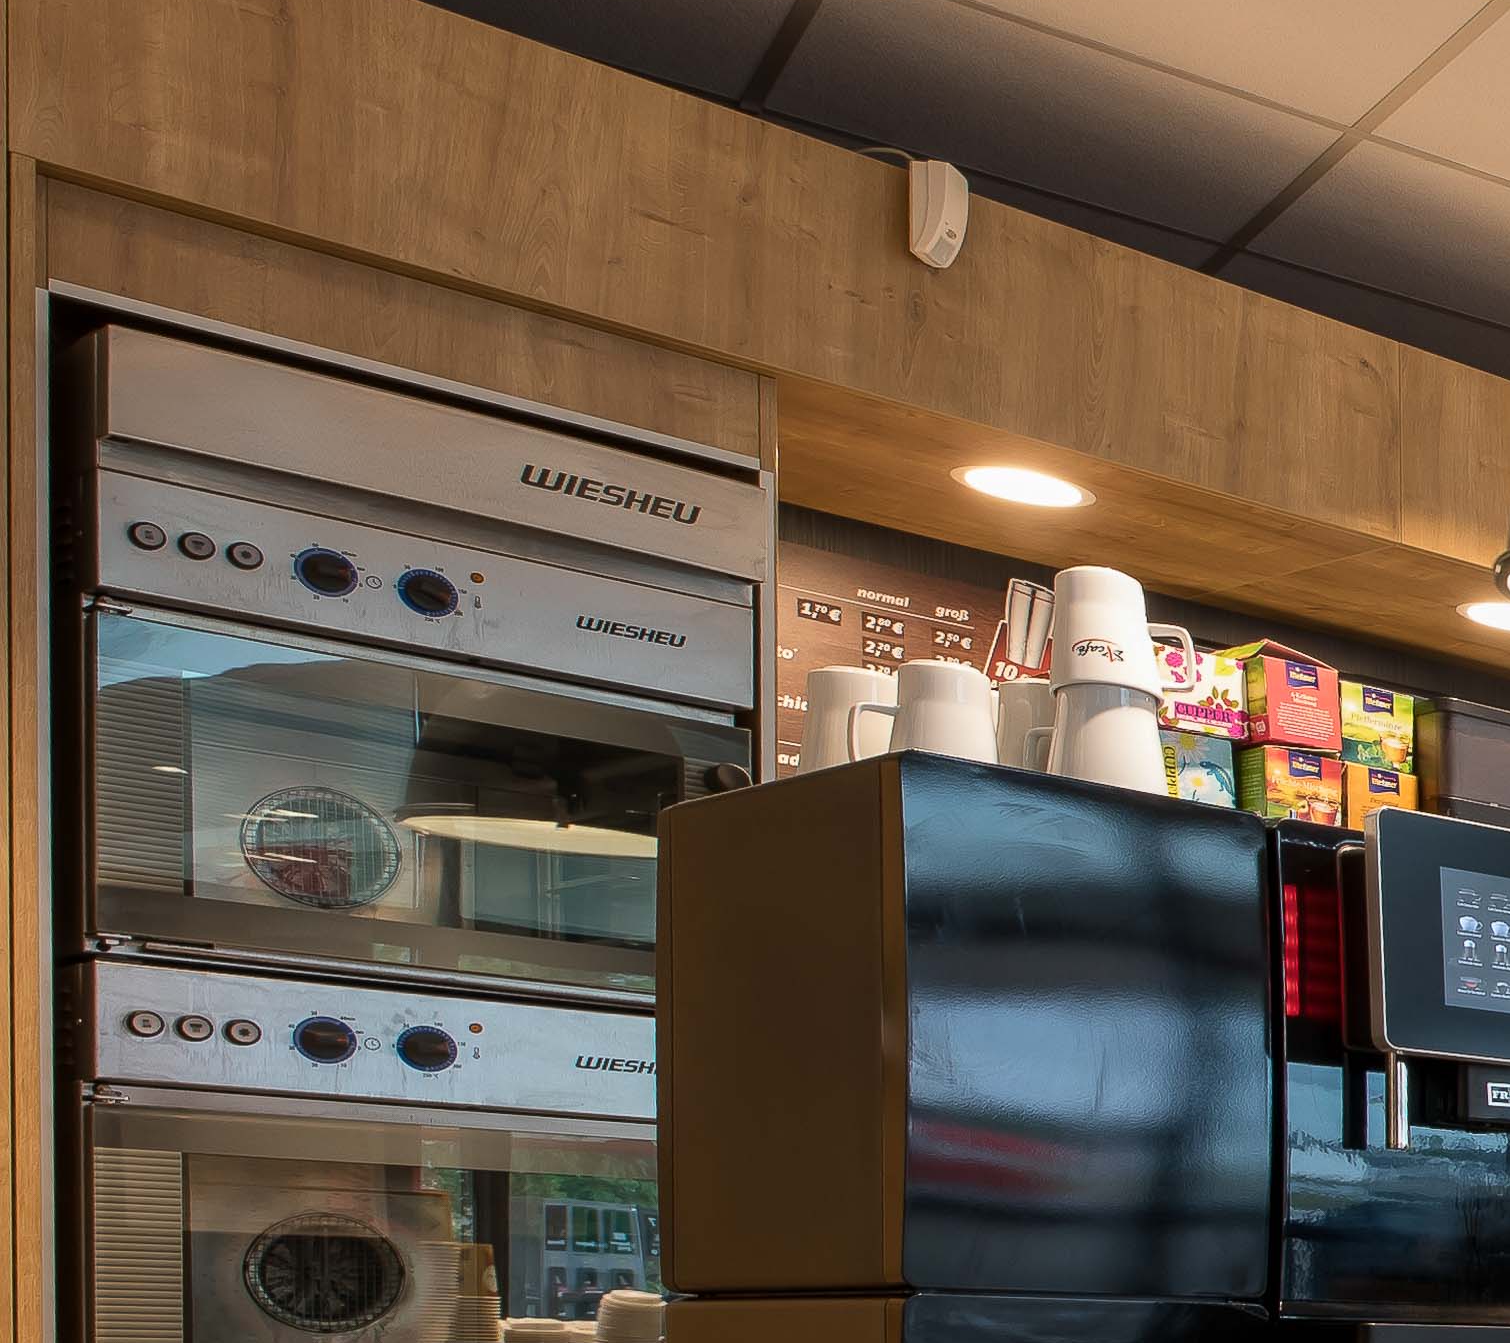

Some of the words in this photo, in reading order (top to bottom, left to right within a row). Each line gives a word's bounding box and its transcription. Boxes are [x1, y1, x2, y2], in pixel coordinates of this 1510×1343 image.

[520, 464, 701, 525] WIESHEU
[857, 589, 910, 607] normal
[935, 607, 970, 621] groß
[576, 615, 686, 648] WIESHEU
[995, 661, 1018, 681] 10
[575, 1055, 656, 1075] WIESH
